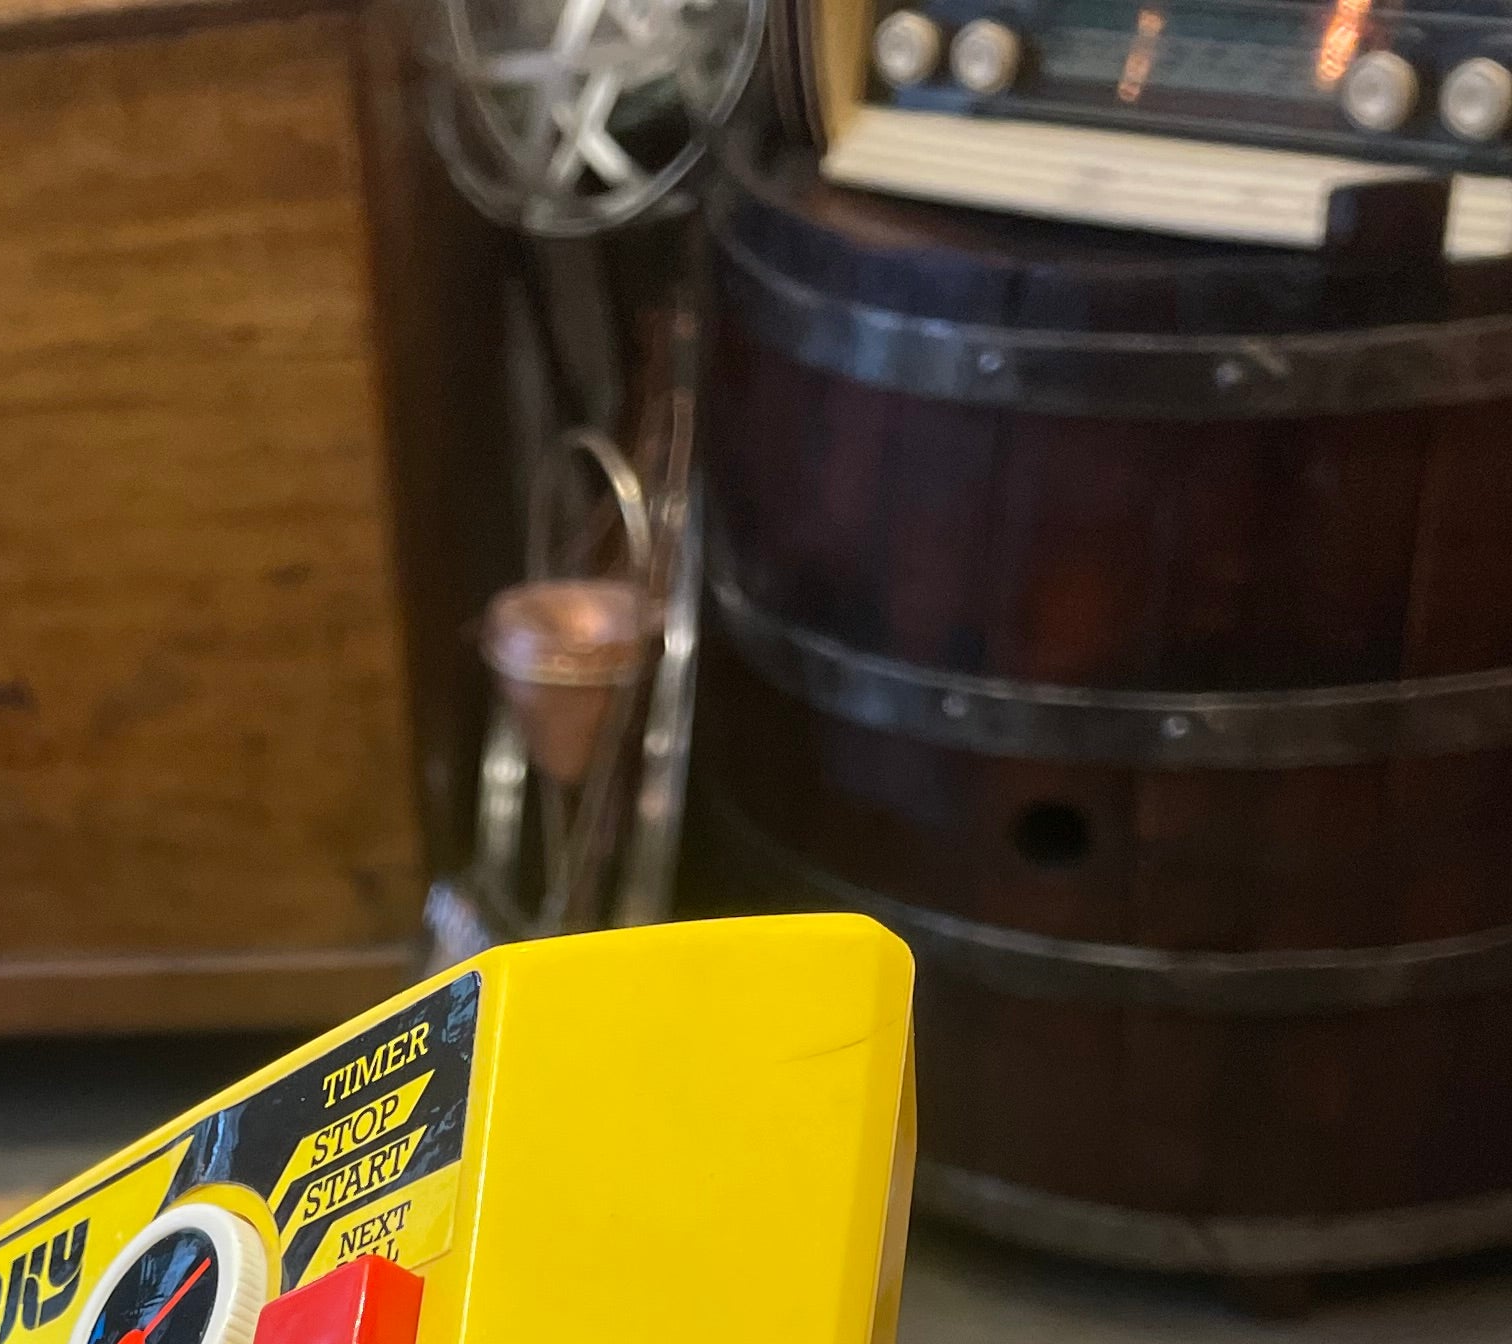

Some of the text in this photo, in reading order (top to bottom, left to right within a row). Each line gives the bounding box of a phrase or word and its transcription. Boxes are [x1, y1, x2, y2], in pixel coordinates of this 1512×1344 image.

[322, 1021, 430, 1109] TIMER
[310, 1093, 400, 1169] STOP
[302, 1136, 411, 1221] START
[337, 1199, 413, 1260] NEXT
